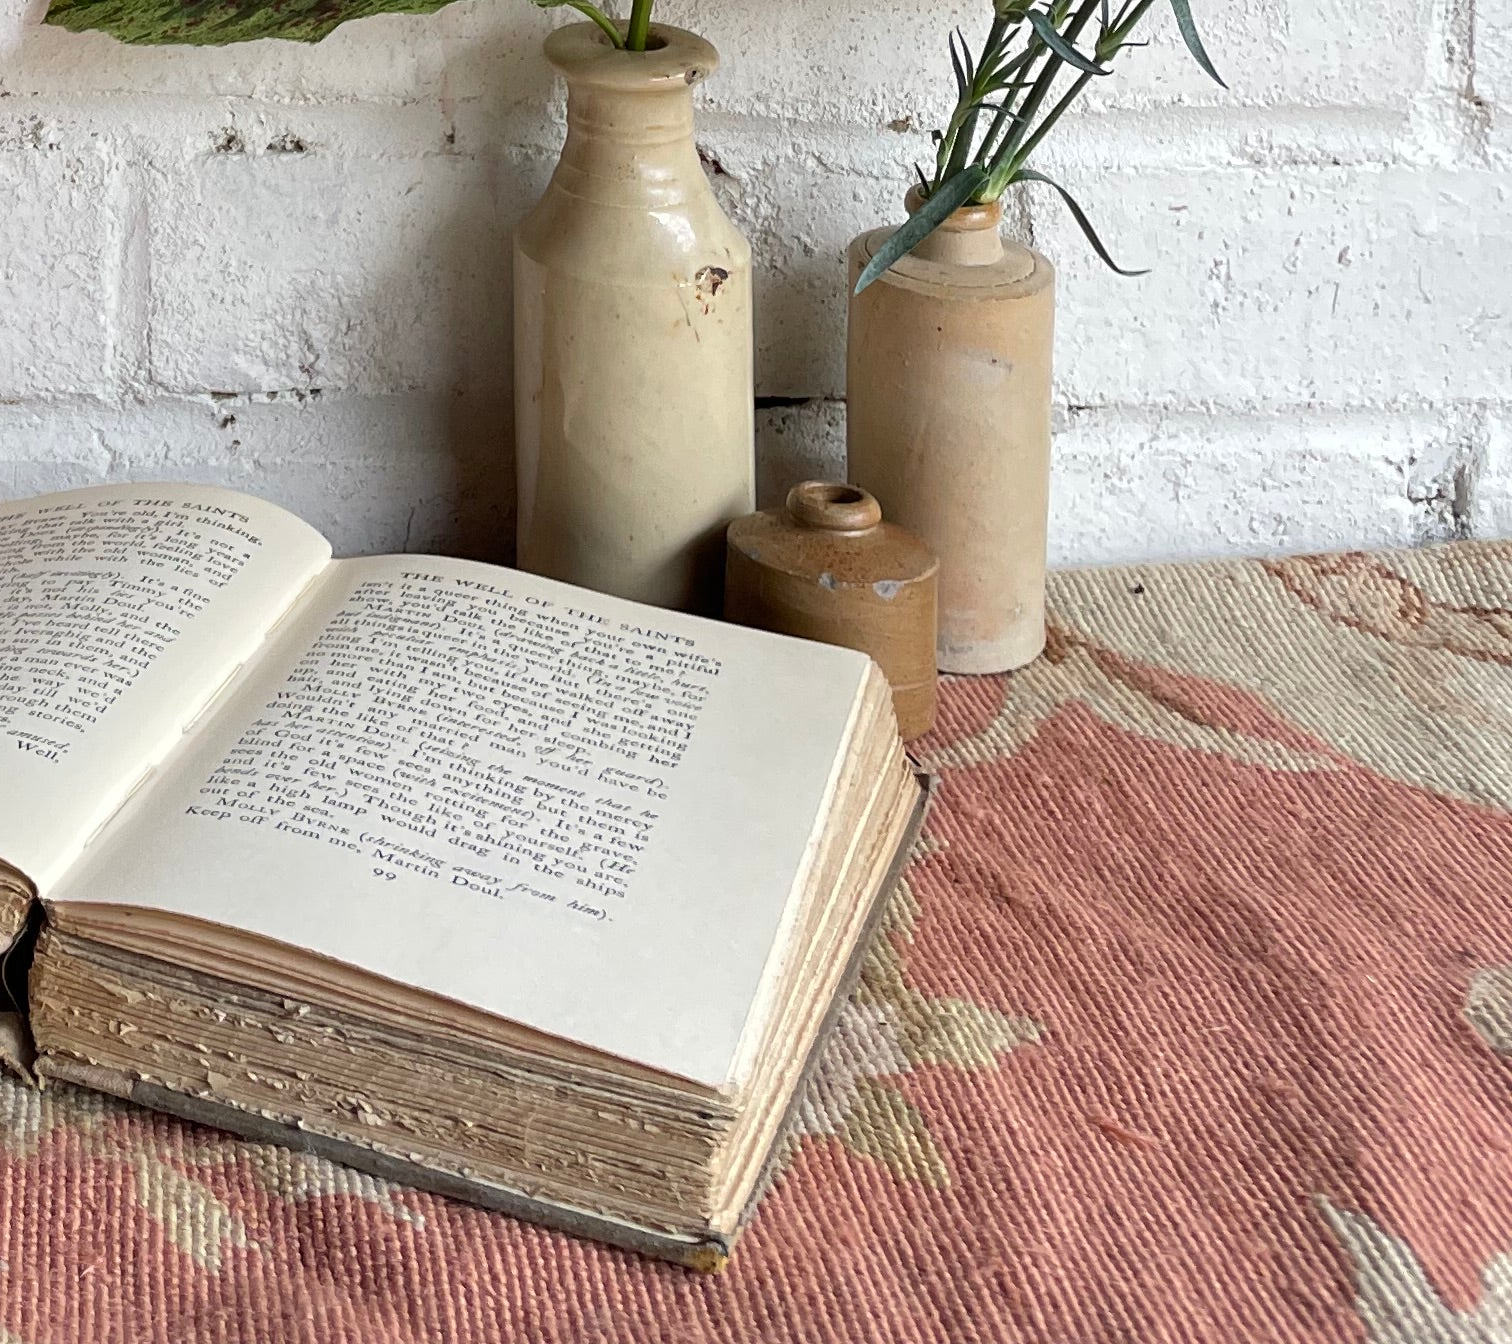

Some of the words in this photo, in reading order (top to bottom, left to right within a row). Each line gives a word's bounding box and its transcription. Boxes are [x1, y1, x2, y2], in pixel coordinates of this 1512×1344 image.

[97, 498, 124, 508] OF
[133, 498, 175, 508] THE
[181, 501, 250, 524] SAINTS
[403, 572, 444, 583] THE
[455, 579, 513, 599] WELL
[525, 596, 555, 609] OF
[620, 623, 695, 647] SAINTS
[53, 703, 98, 725] them
[222, 757, 255, 766] and
[263, 759, 291, 771] it's
[303, 767, 337, 781] few
[345, 779, 379, 794] sees
[389, 791, 418, 806] the
[427, 803, 463, 821] like
[473, 820, 492, 831] of
[501, 829, 583, 861] yourself.
[599, 858, 636, 874] (He
[230, 748, 263, 756] sees
[270, 750, 299, 761] the
[308, 758, 337, 770] old
[349, 767, 412, 793] women
[424, 791, 489, 819] rotting
[500, 815, 528, 829] for
[540, 828, 570, 843] the
[579, 842, 638, 866] grave,
[274, 729, 313, 742] God
[319, 736, 345, 749] it's
[355, 745, 389, 760] few
[398, 759, 431, 774] sees
[442, 773, 524, 806] anything
[536, 800, 568, 817] but
[578, 815, 625, 836] them
[185, 806, 232, 821] Keep
[239, 815, 265, 825] off
[274, 821, 320, 840] from
[371, 848, 439, 878] Martin
[451, 874, 504, 900] Doul.
[207, 775, 241, 785] like
[269, 782, 311, 800] high
[321, 795, 368, 816] lamp
[381, 814, 437, 838] would
[448, 836, 491, 857] drag
[502, 852, 520, 865] in
[534, 863, 565, 878] the
[576, 878, 625, 898] ships
[216, 797, 281, 816] MOLLY
[290, 811, 350, 836] BYRNE
[359, 832, 447, 869] (shrinking
[452, 865, 504, 887] away
[509, 883, 556, 902] from
[566, 899, 613, 922] him).
[372, 866, 398, 882] 99
